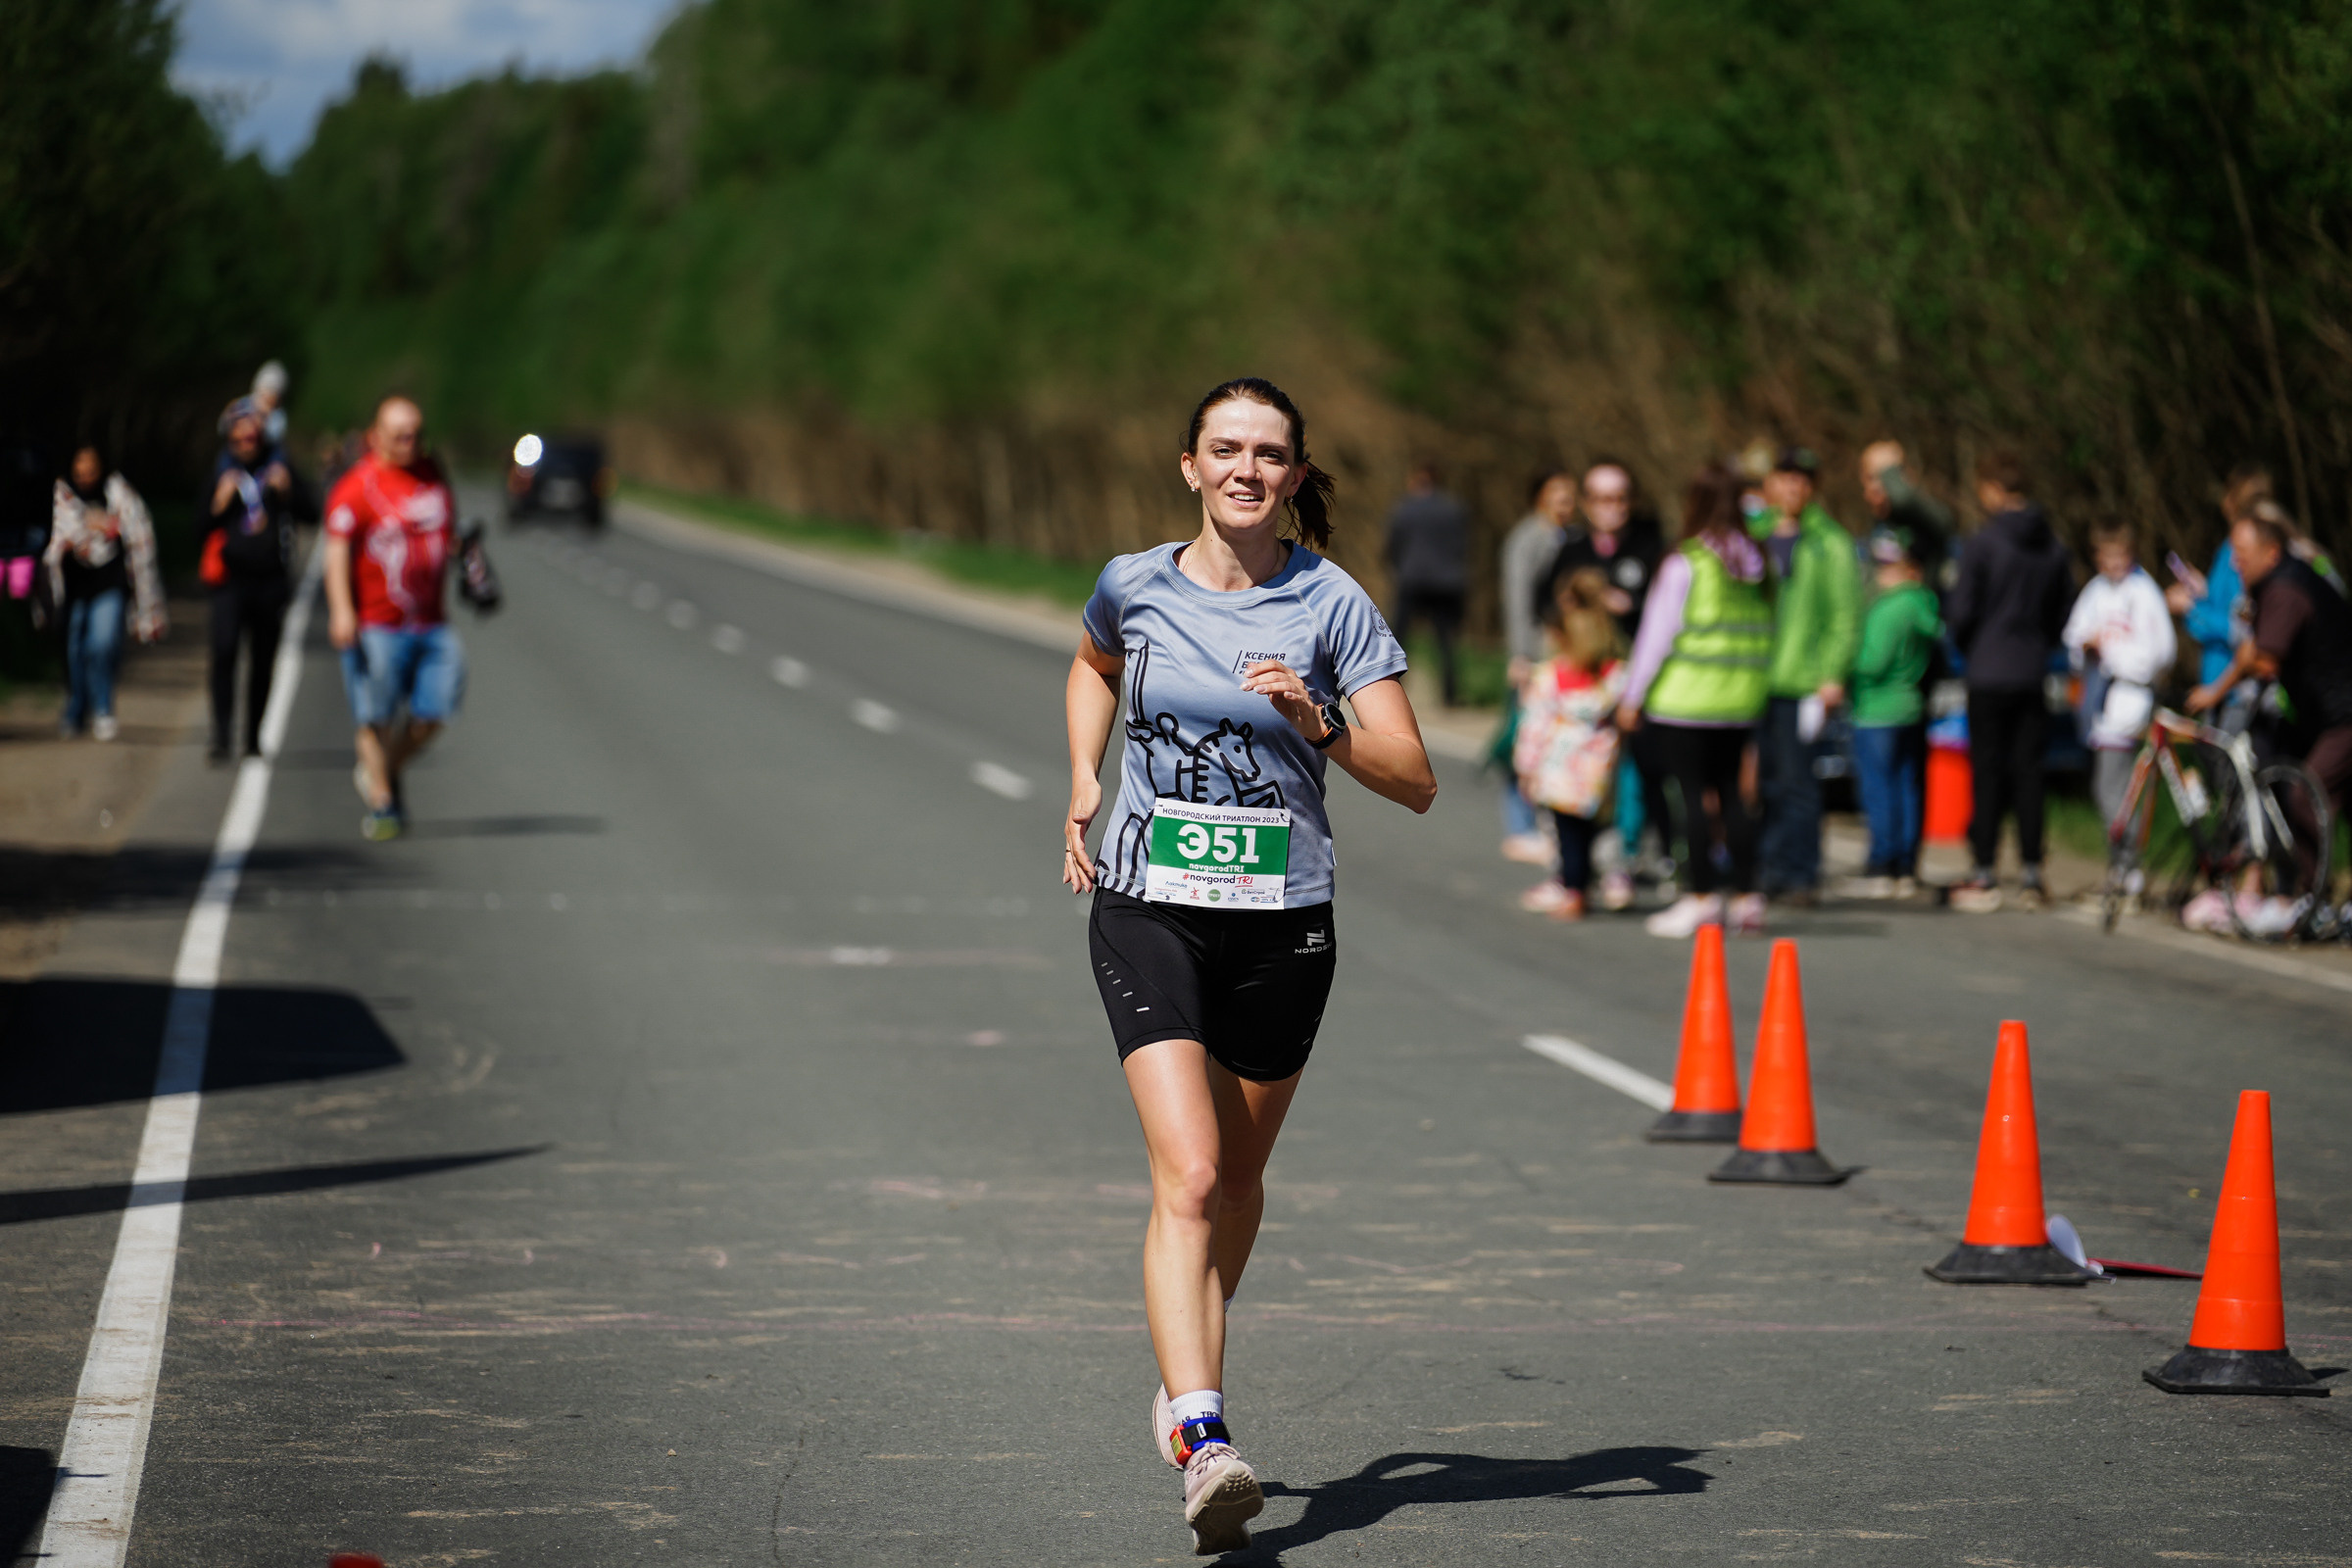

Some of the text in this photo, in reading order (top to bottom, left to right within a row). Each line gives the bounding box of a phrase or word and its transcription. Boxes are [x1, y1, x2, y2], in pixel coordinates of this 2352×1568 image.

[1245, 652, 1286, 662] КСЕНИЯ
[1162, 808, 1221, 821] НОВГОРОДСКИЙ
[1222, 814, 1261, 823] ТРИАТЛОН
[1189, 862, 1245, 873] novgorodTRI
